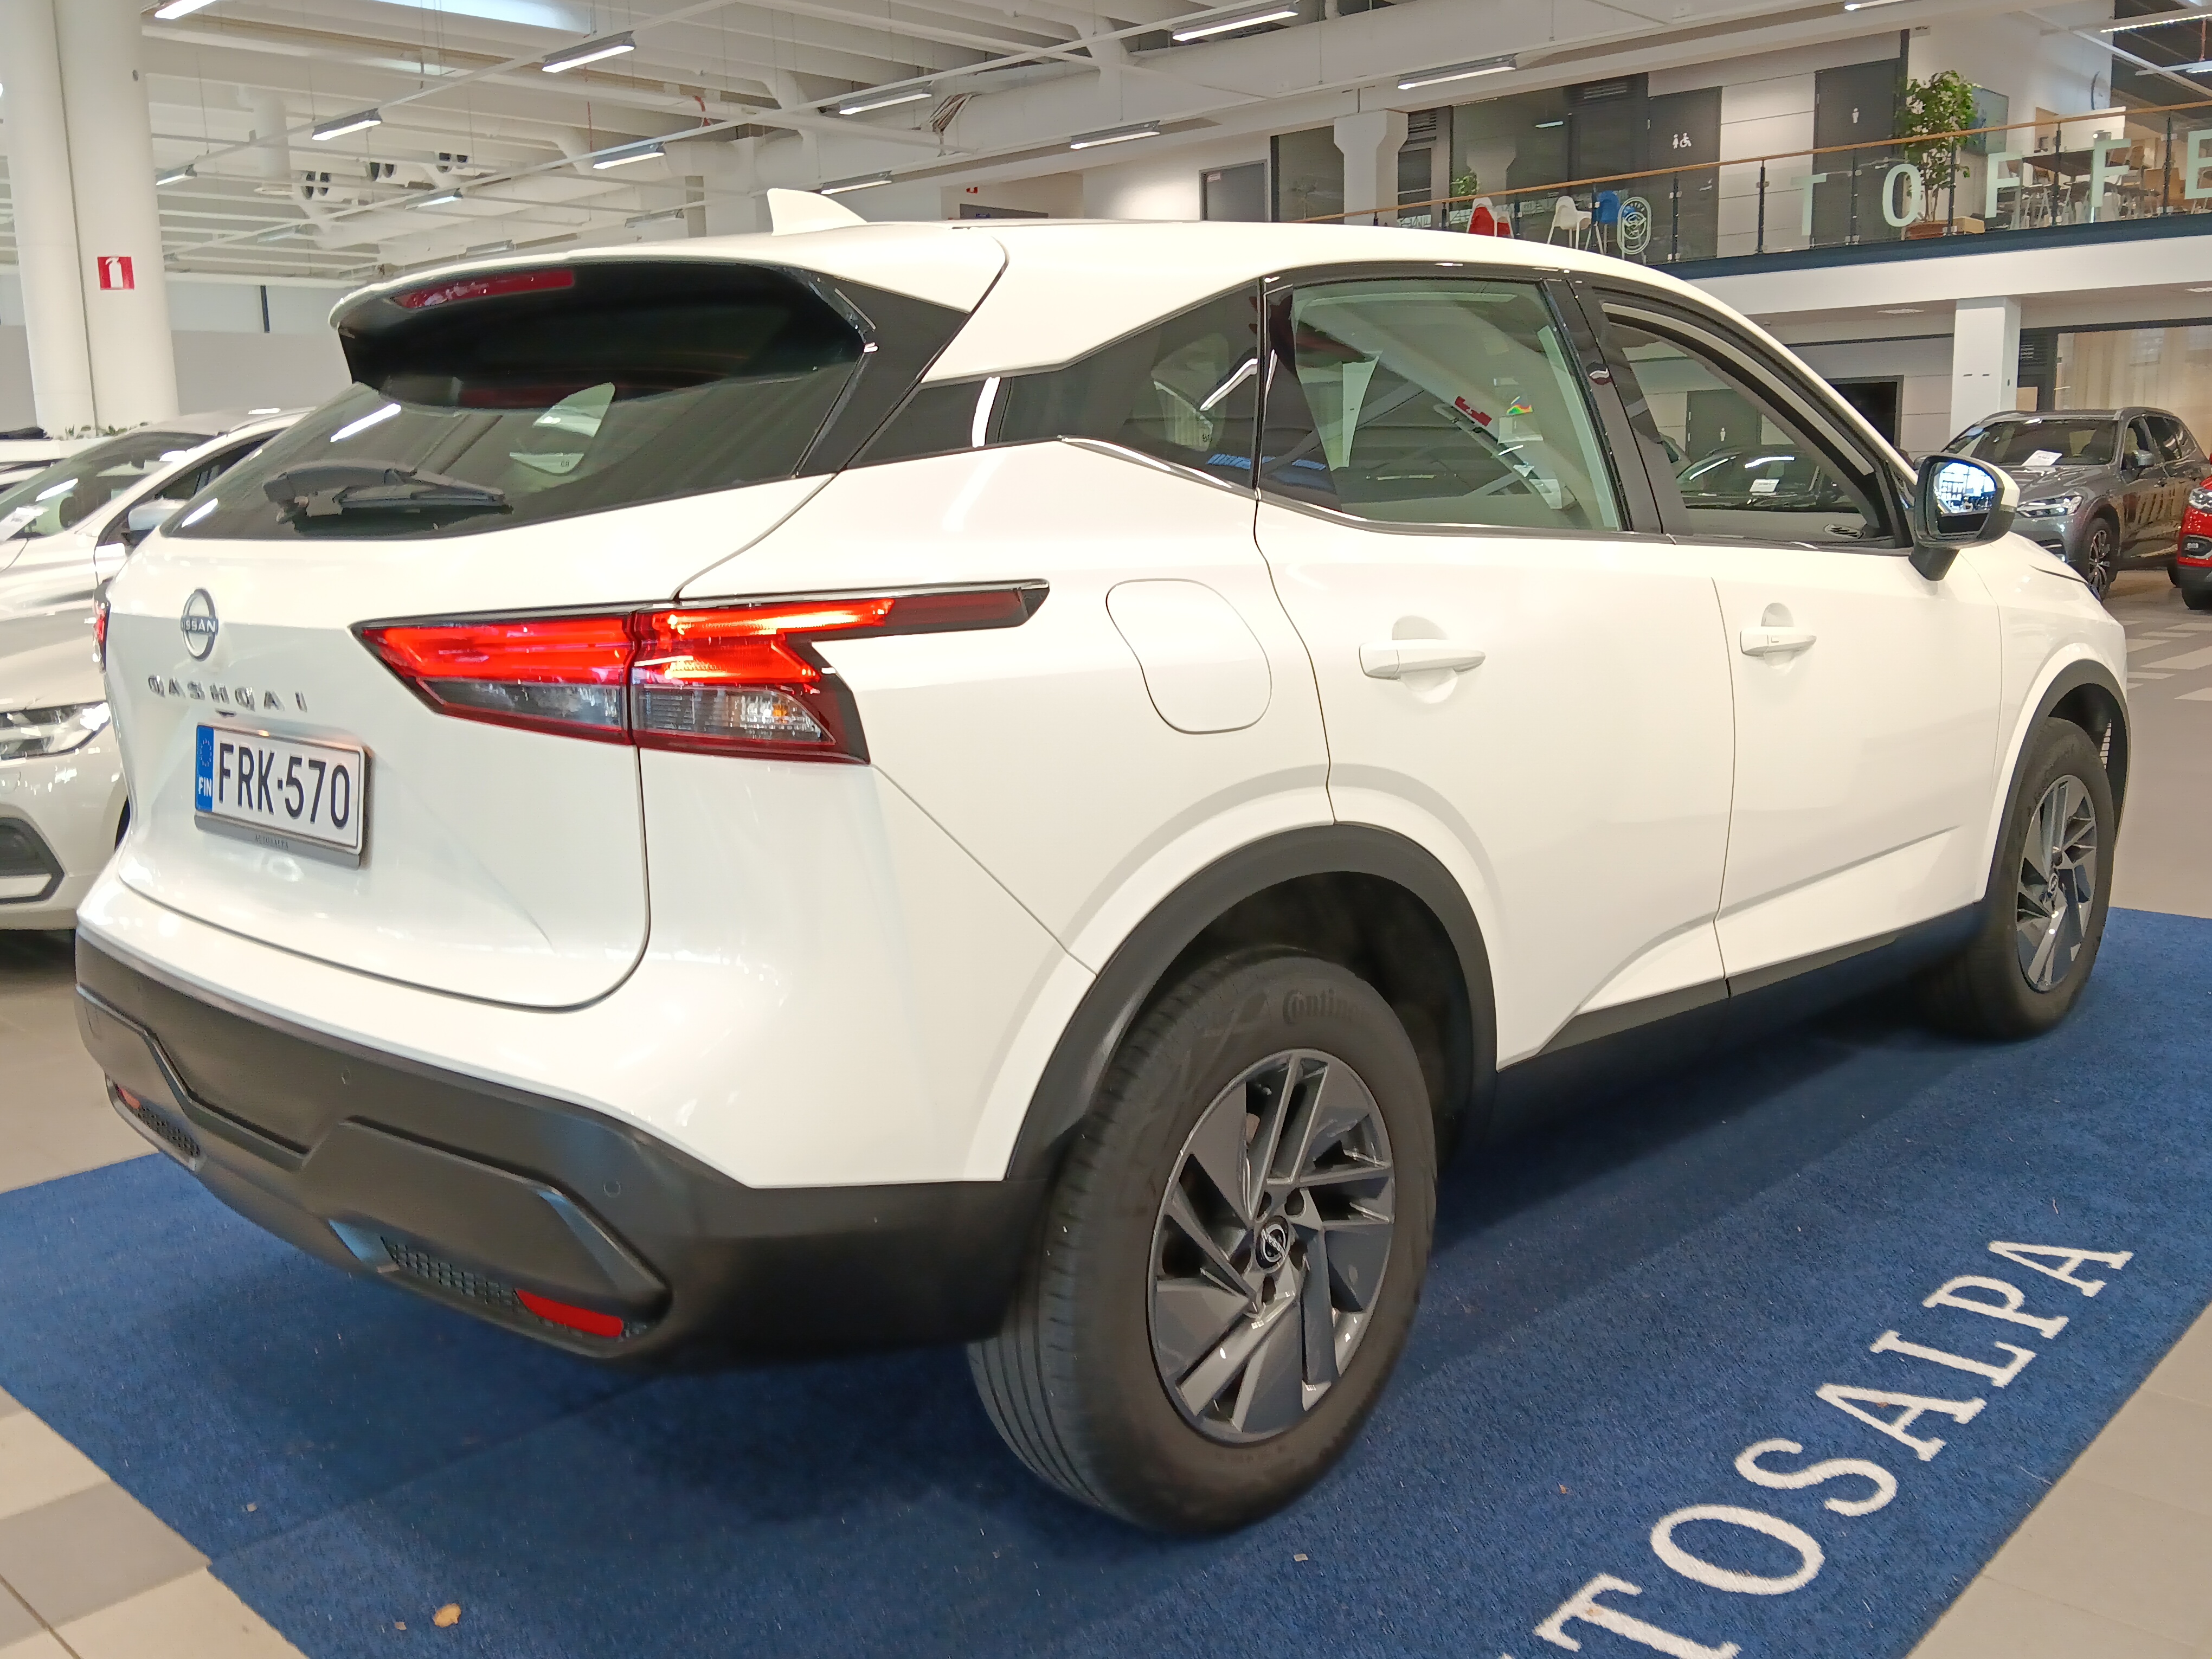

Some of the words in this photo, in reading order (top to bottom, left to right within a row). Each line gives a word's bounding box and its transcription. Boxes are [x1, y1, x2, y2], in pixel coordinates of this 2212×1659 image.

[148, 674, 307, 712] QASHQAI
[198, 776, 212, 797] FIN
[218, 742, 350, 829] FRK-570
[1500, 1240, 2134, 1659] TOSALPA
